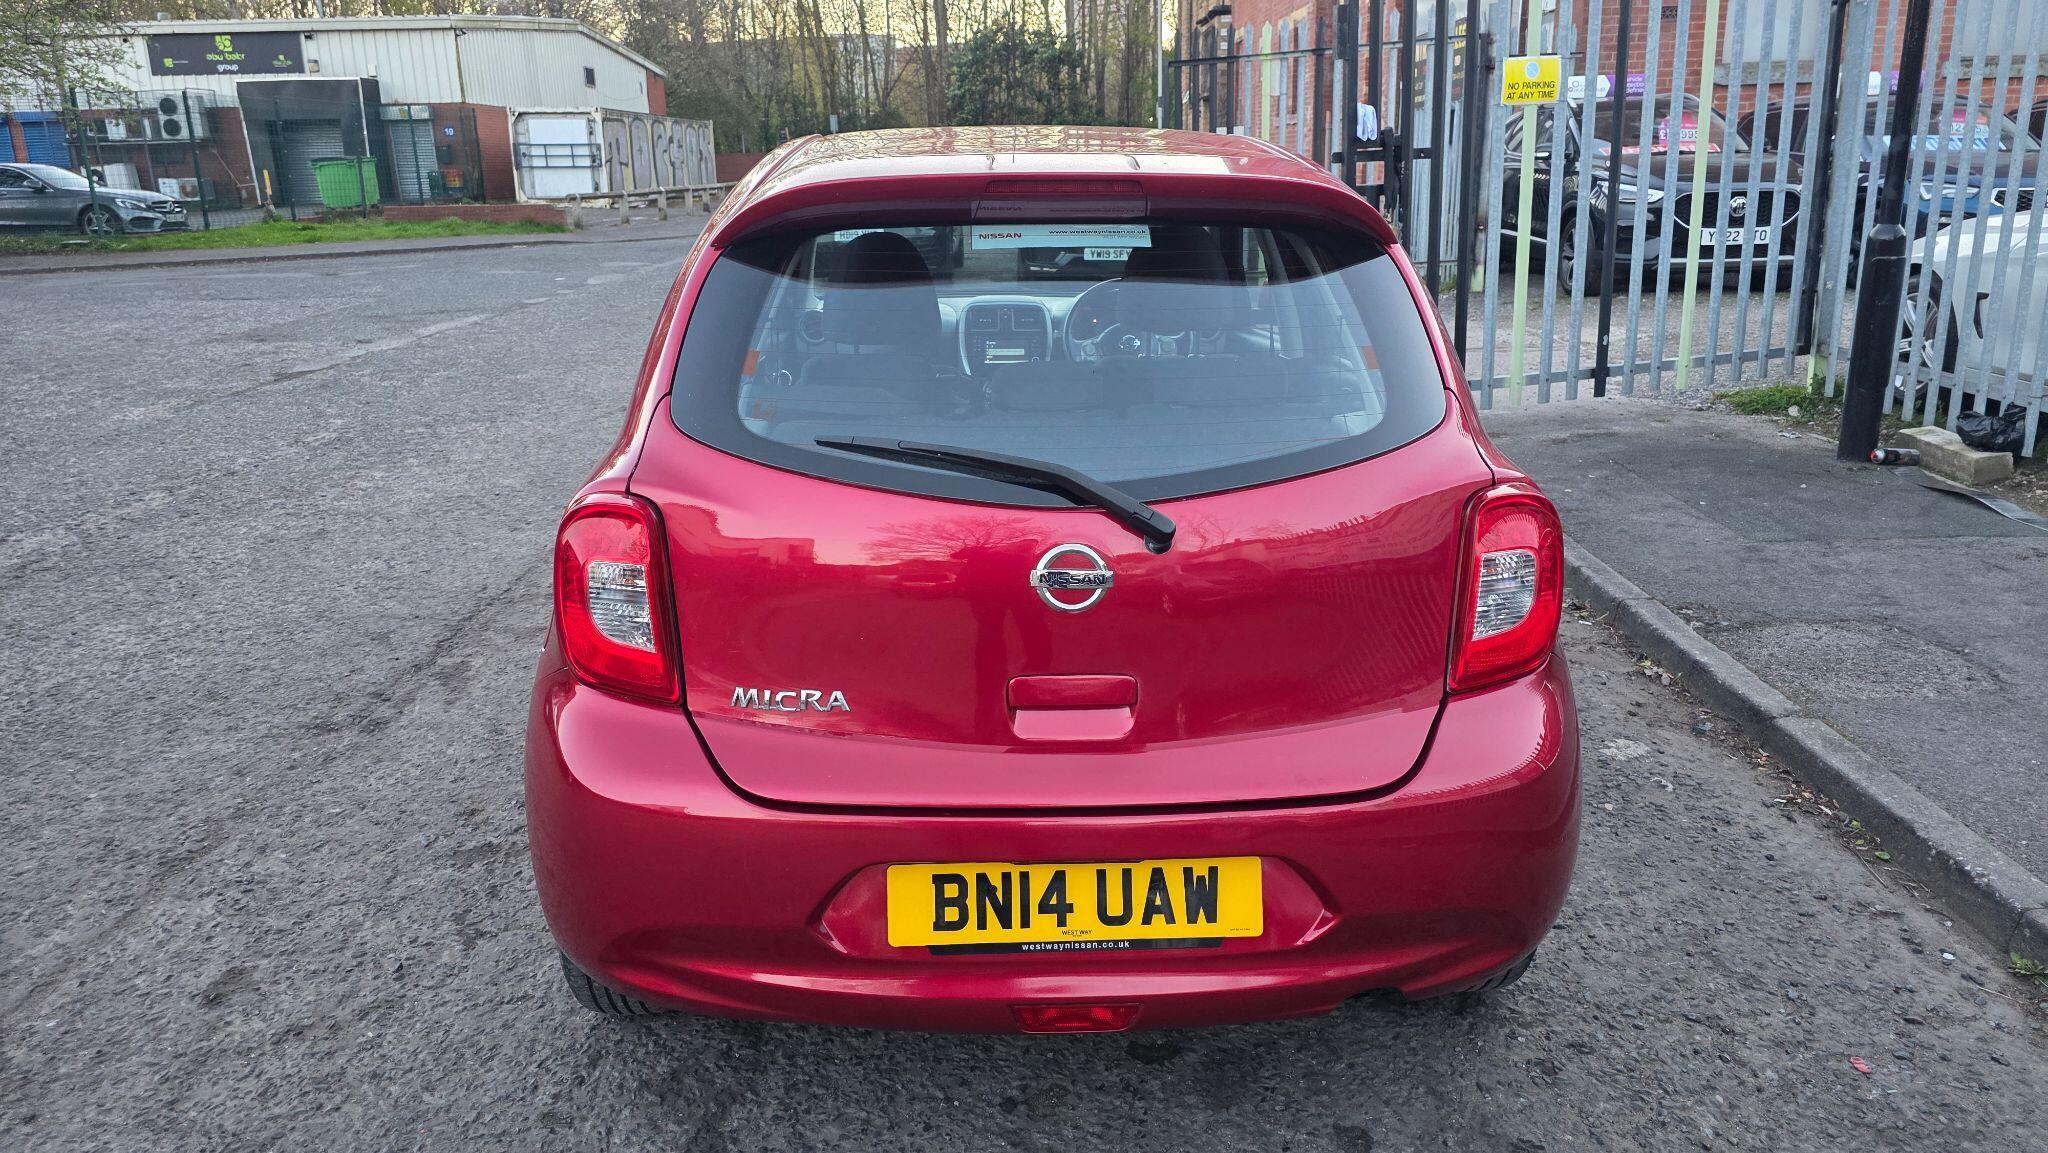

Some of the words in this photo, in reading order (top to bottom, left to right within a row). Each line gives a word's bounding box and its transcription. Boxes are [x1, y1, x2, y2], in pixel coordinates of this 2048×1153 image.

[217, 63, 239, 72] group
[1508, 82, 1520, 91] NO
[1522, 80, 1555, 90] PARKING
[1507, 92, 1516, 100] AT
[1518, 91, 1535, 100] ANY
[1537, 90, 1555, 98] TIME
[1708, 230, 1740, 243] Y22
[1039, 571, 1106, 587] NISSAN
[731, 686, 851, 712] MICRA
[931, 869, 1075, 932] BN14
[1095, 865, 1219, 927] UAW
[1022, 940, 1130, 951] westwaynissan.co.uk
